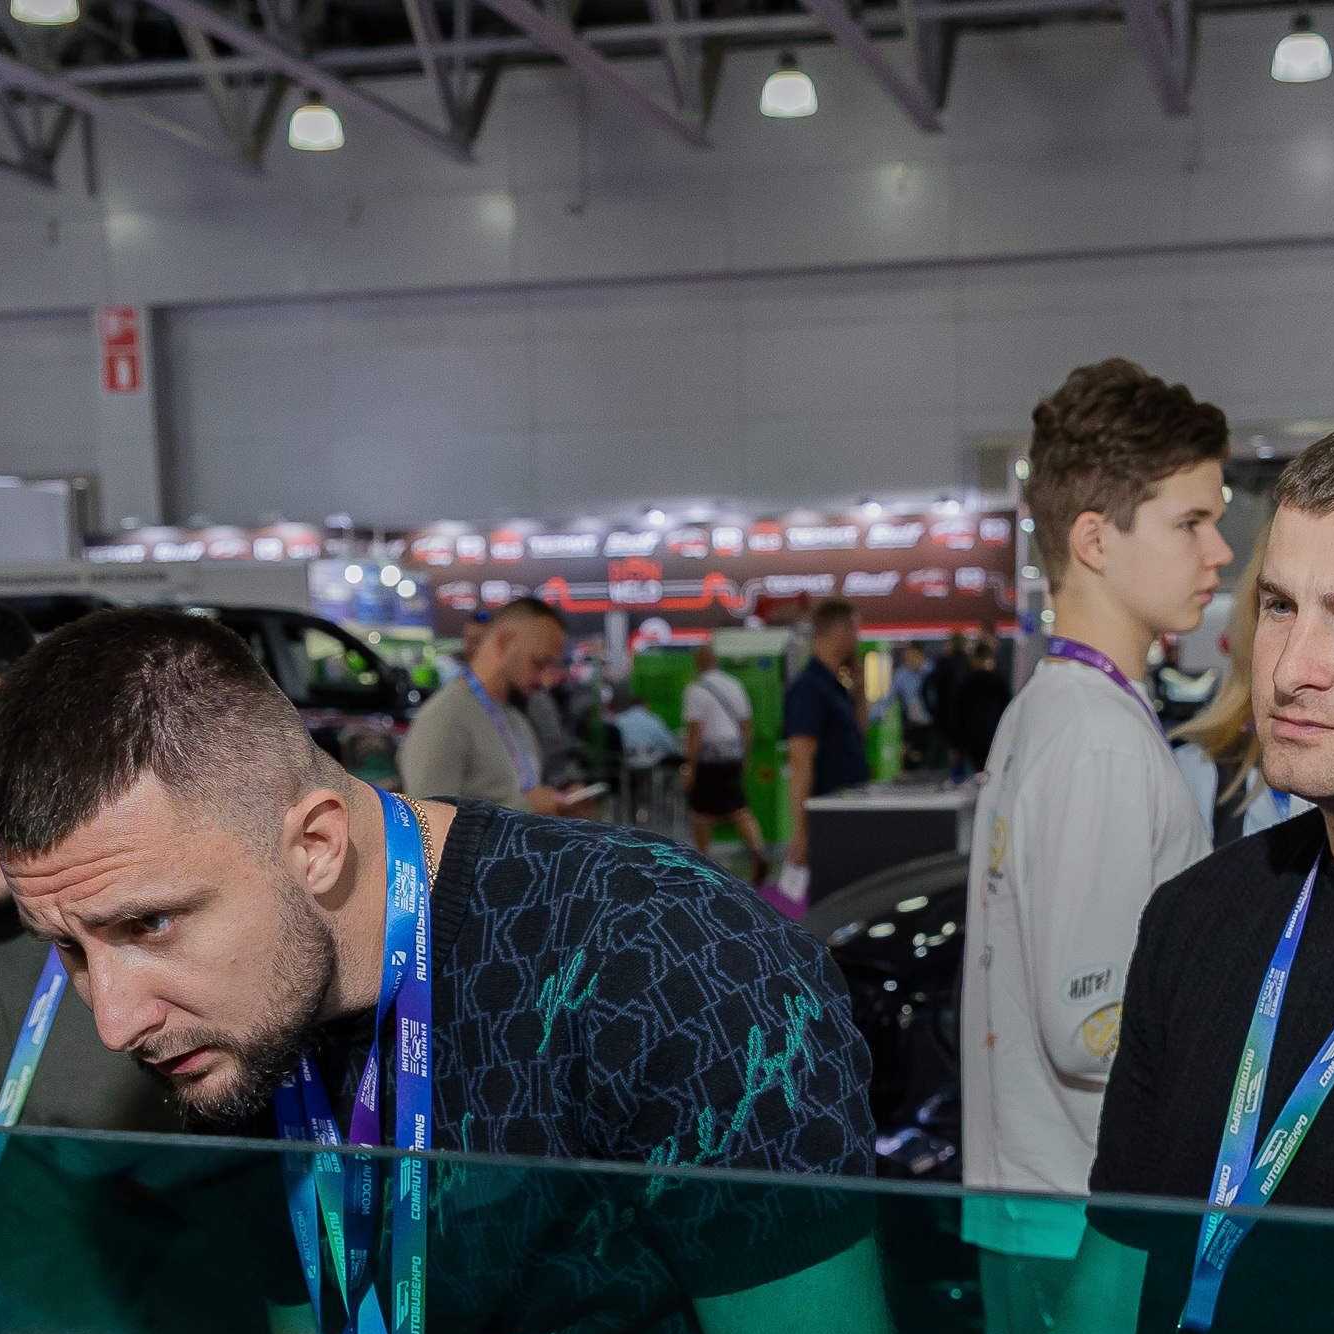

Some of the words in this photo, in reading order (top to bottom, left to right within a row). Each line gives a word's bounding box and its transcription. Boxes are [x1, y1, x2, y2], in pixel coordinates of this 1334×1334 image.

[1229, 1047, 1255, 1135] AUTOBUSEXPO
[362, 1164, 372, 1215] AUTOCOM
[1260, 1114, 1309, 1196] AUTOBUSEXPO
